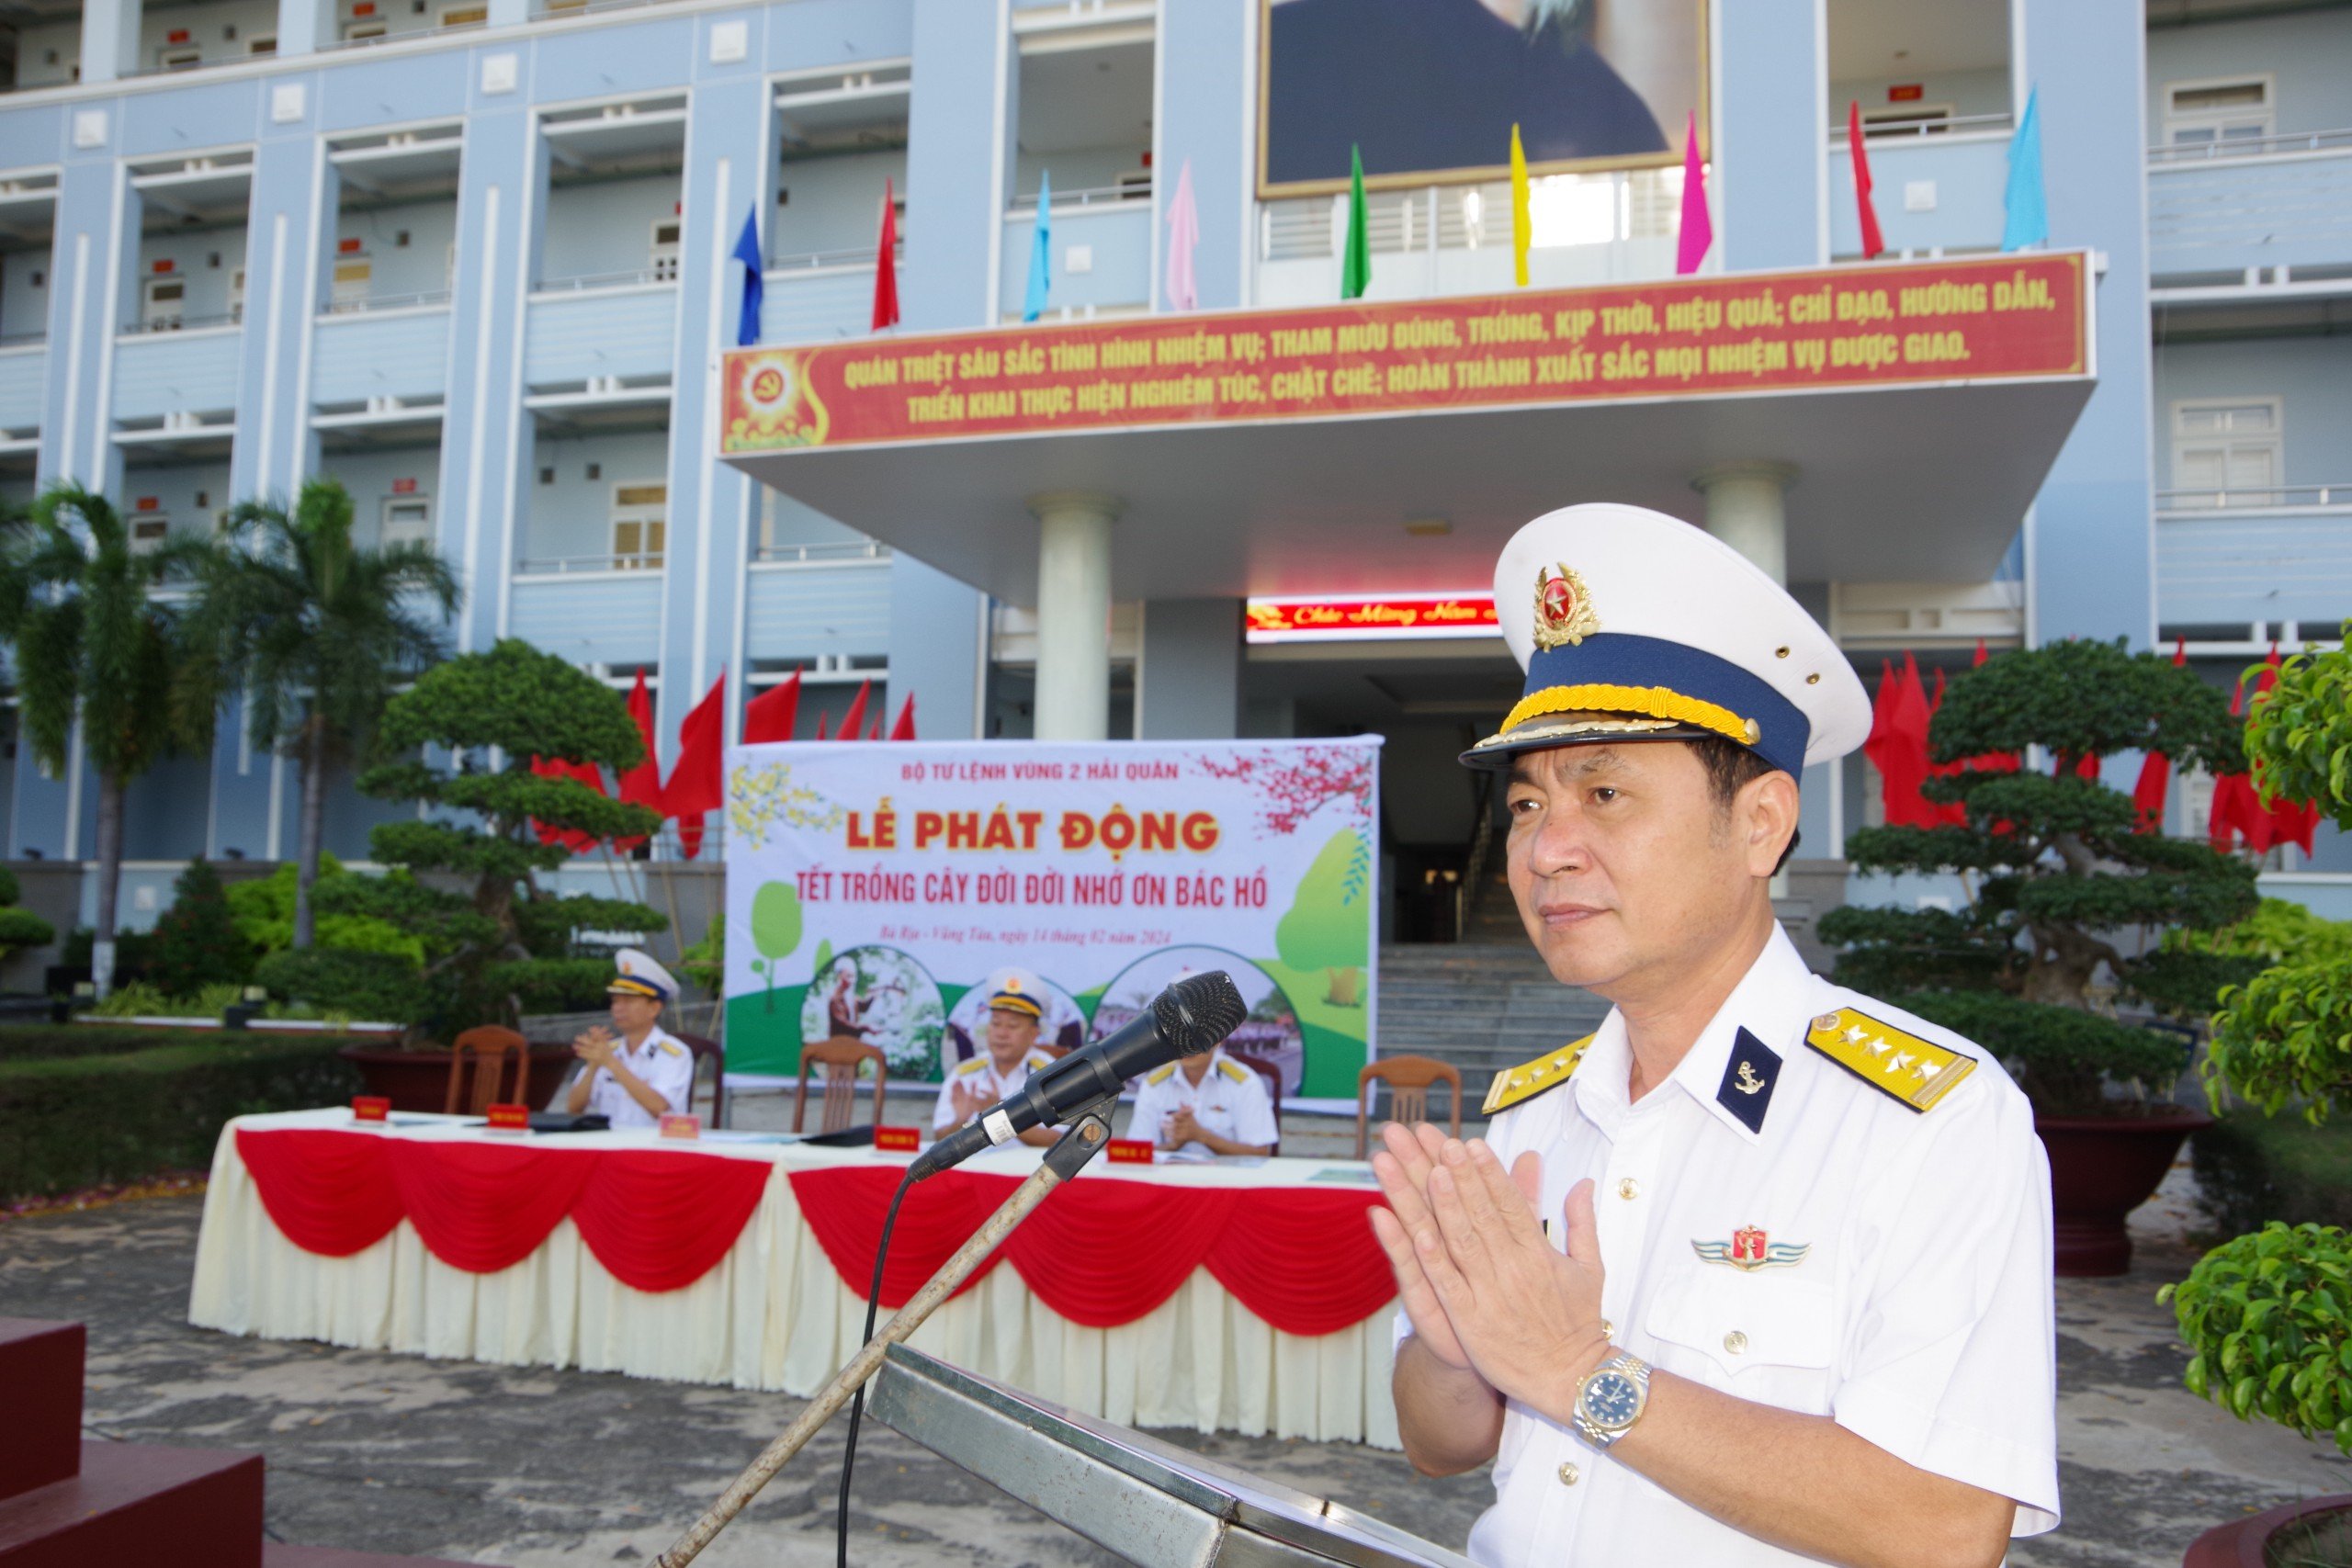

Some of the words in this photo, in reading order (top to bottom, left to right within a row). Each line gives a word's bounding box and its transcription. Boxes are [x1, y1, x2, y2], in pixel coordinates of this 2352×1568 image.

[902, 350, 955, 386] TRIỆT
[959, 346, 1000, 379] SÂU
[1003, 340, 1046, 376] SẮC
[1049, 341, 1096, 373] TÌNH
[1101, 336, 1151, 368] HÌNH
[1157, 331, 1227, 367] NHIỆM
[1271, 326, 1332, 357] THAM
[1337, 322, 1388, 355] MƯU
[1392, 315, 1462, 350] ĐÚNG,
[1467, 310, 1549, 344] TRÚNG,
[1555, 308, 1595, 344] KỊP
[1600, 299, 1660, 336] THỜI,
[1666, 295, 1722, 336] HIỆU
[1726, 287, 1784, 330] QUẢ;
[1789, 284, 1832, 324] CHỈ
[1837, 289, 1894, 326] ĐẠO,
[1899, 278, 1987, 317] HƯỚNG
[1993, 269, 2055, 311] DẪN,
[908, 386, 965, 423] TRIỂN
[968, 389, 1016, 419] KHAI
[1020, 385, 1072, 420] THỰC
[1077, 378, 1126, 415] HIỆN
[1130, 374, 1214, 407] NGHIÊM
[1218, 370, 1267, 403] TÚC,
[1272, 361, 1328, 404] CHẶT
[1387, 357, 1450, 393] HOÀN
[1455, 354, 1531, 389] THÀNH
[1536, 343, 1597, 384] XUẤT
[1601, 340, 1650, 380] SẮC
[1655, 346, 1702, 382] MỌI
[1707, 336, 1788, 378] NHIỆM
[1793, 339, 1826, 375] VỤ
[1830, 333, 1898, 371] ĐƯỢC
[1904, 330, 1970, 363] GIAO.
[901, 762, 925, 784] BỘ
[933, 762, 955, 780] TƯ
[959, 761, 1006, 784] LỆNH
[1013, 760, 1062, 780] VÙNG
[1069, 763, 1080, 779] 2
[1088, 759, 1118, 779] HẢI
[1125, 760, 1178, 782] QUÂN
[845, 795, 896, 850] LỄ
[914, 802, 1043, 850] PHÁT
[1059, 802, 1219, 863] ĐỘNG
[797, 863, 832, 901] TẾT
[924, 866, 967, 903] CÂY
[978, 865, 1015, 904] ĐỜI
[1025, 865, 1064, 905] ĐỜI
[1073, 868, 1125, 906] NHỚ
[1133, 873, 1165, 906] ƠN
[1176, 869, 1224, 908] BÁC
[1140, 930, 1171, 944] 2024
